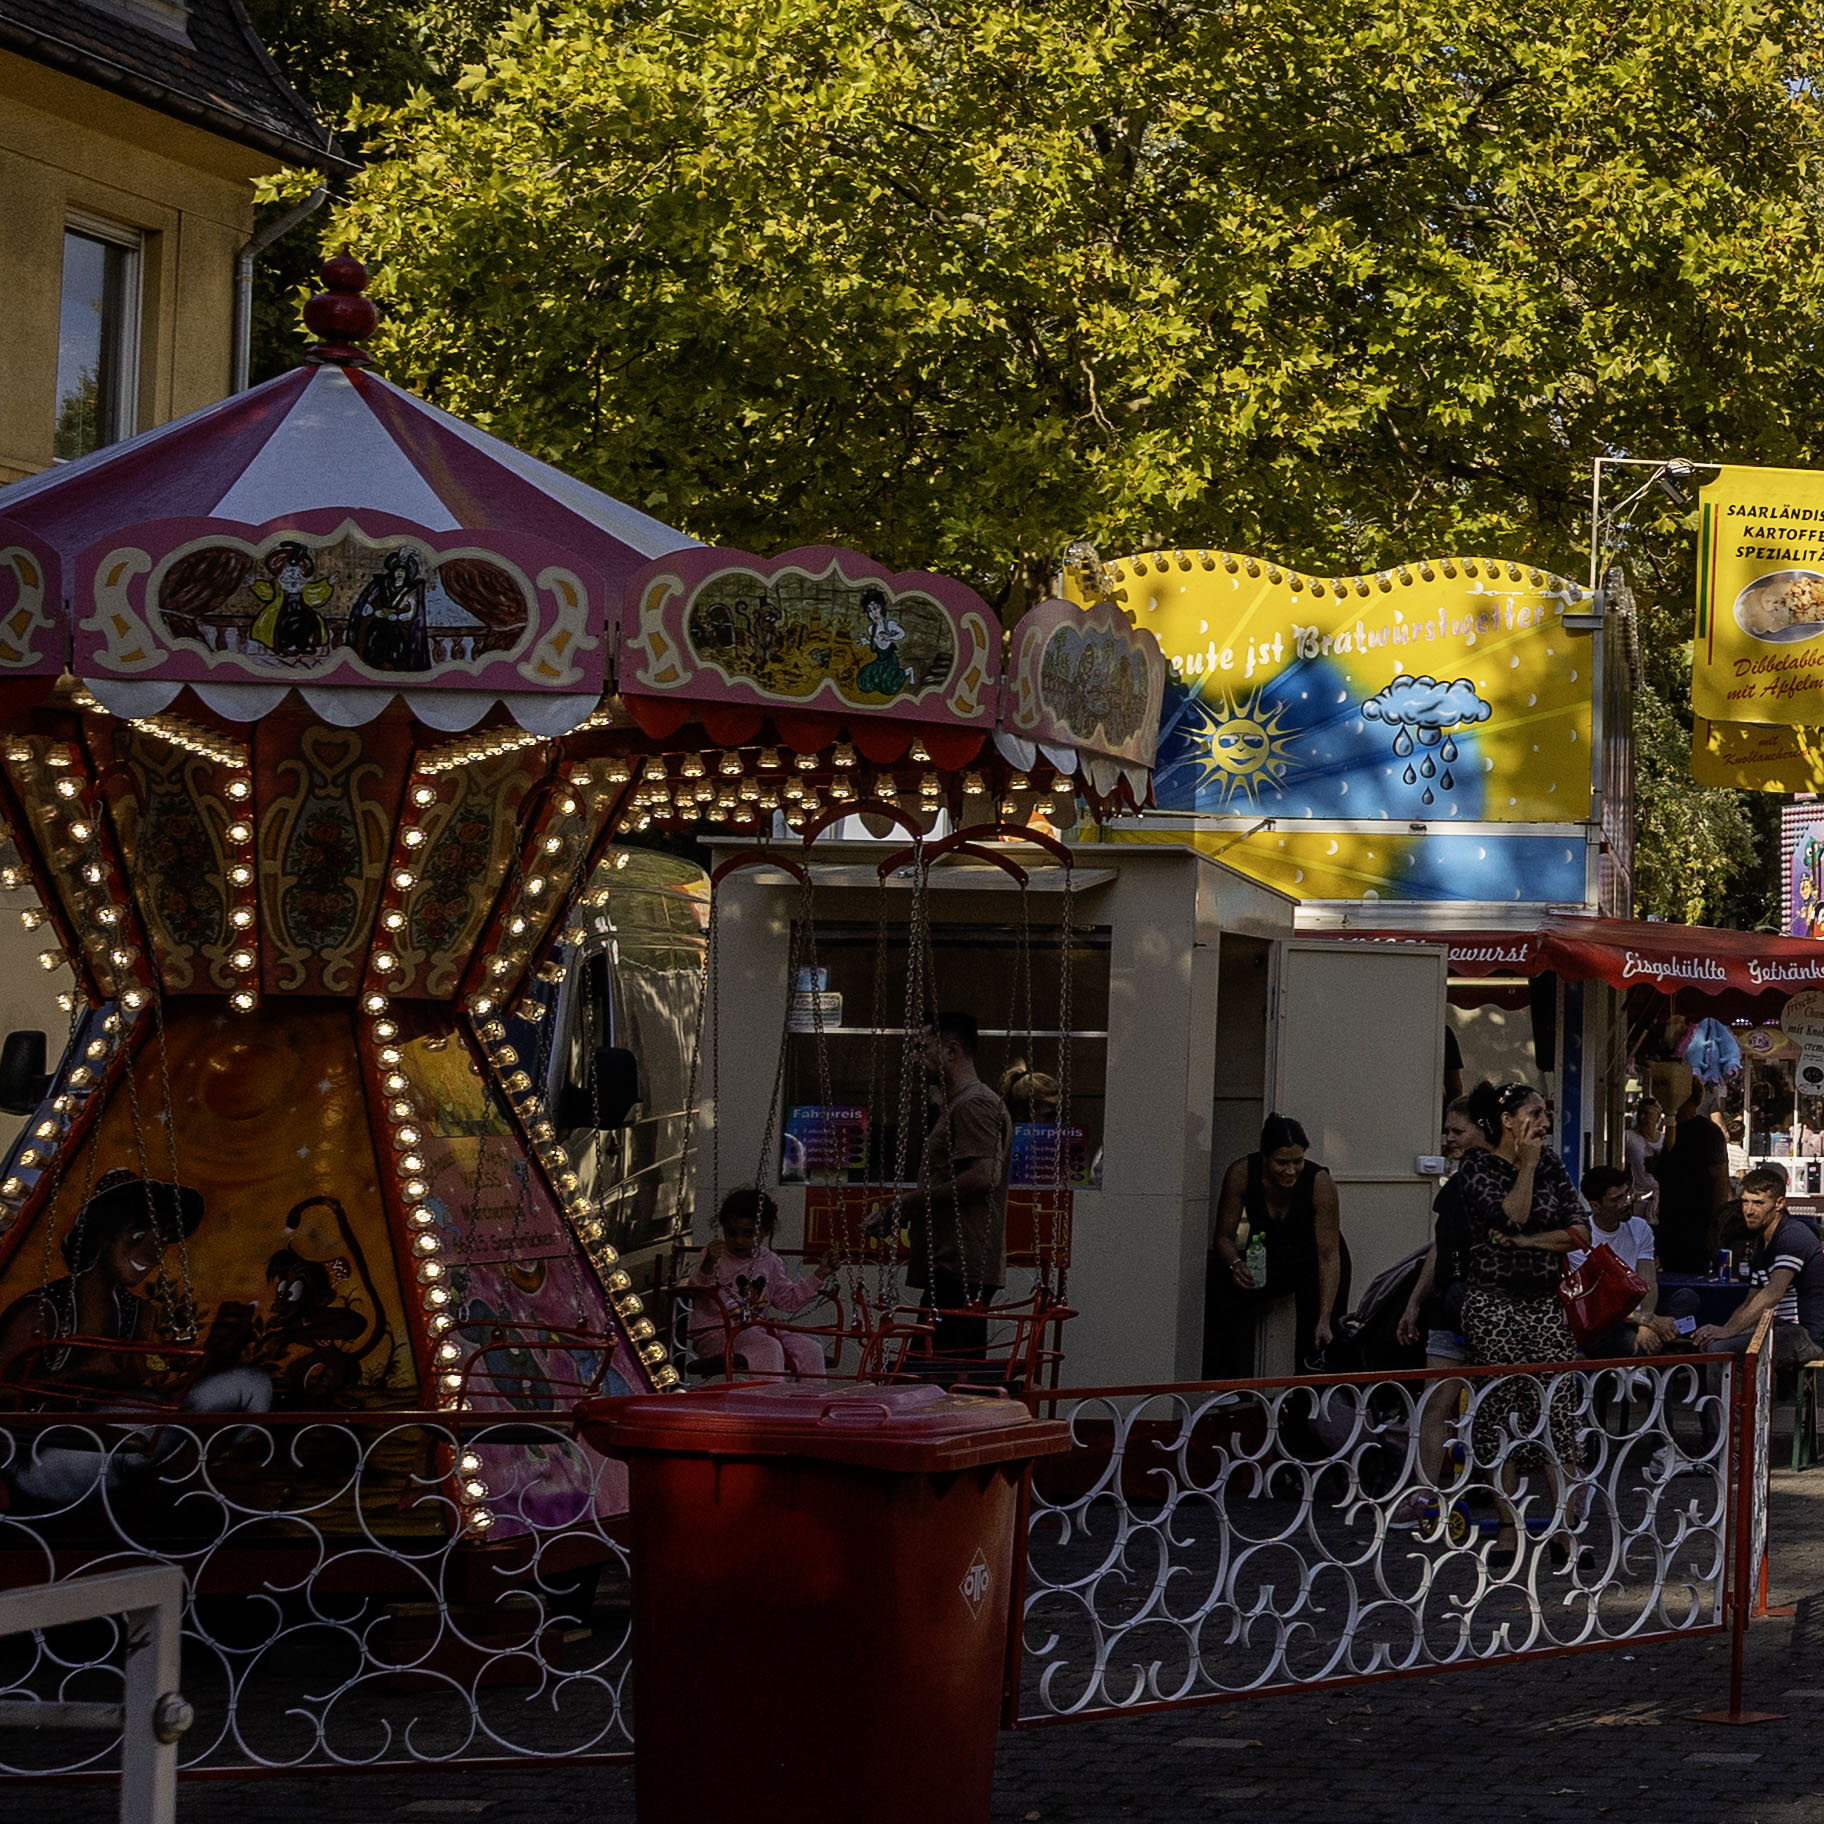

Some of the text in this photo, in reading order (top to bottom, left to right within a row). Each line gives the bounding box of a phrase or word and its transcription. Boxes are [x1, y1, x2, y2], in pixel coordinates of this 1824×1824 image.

[1171, 641, 1235, 677] eute
[1296, 599, 1545, 661] Bratwurstwetter
[1727, 683, 1757, 701] mit
[1449, 944, 1528, 963] ewurst
[1623, 951, 1727, 981] Eisgekühlte
